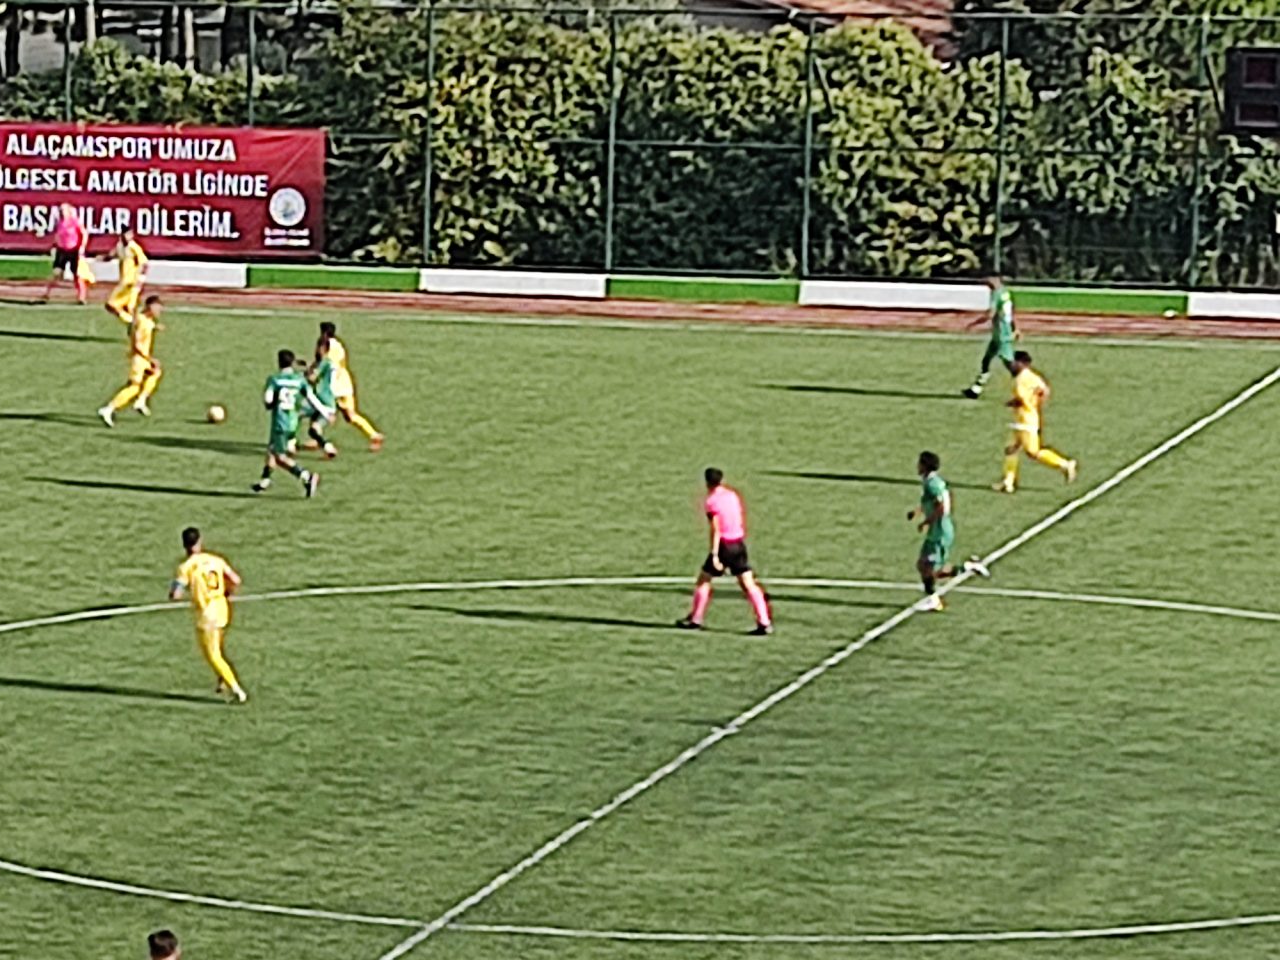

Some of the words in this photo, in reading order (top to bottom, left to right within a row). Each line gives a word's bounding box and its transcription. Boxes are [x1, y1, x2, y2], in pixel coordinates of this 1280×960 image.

[6, 133, 237, 162] ALAÇAMSPOR'UMUZA
[87, 167, 178, 194] AMATÖR
[3, 204, 131, 237] BAŞAILAR
[137, 203, 240, 238] DİLERİM.
